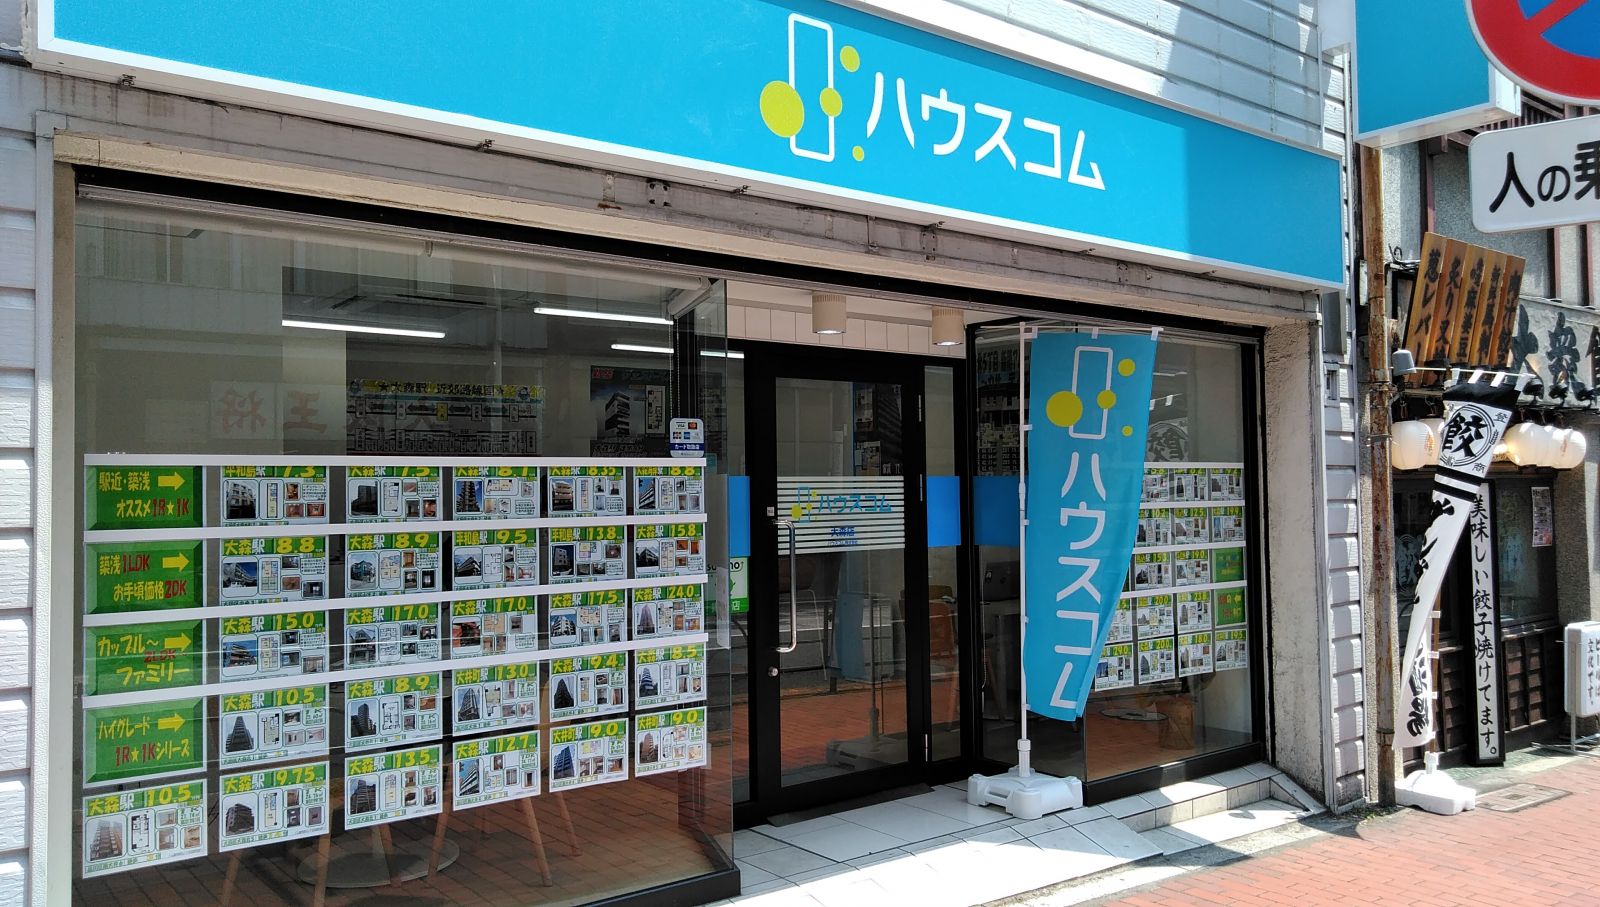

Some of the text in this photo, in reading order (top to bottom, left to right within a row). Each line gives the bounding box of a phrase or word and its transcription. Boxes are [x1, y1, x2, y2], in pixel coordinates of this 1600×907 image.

[867, 71, 1107, 191] ハウスコム
[1443, 412, 1488, 457] 餃
[99, 471, 151, 492] 駅近・築浅
[819, 495, 892, 513] ハウスコム
[351, 533, 430, 550] 大森駅 8.9
[456, 530, 528, 546] 平和島駅 9.5
[551, 527, 616, 543] 平和島駅 13.8
[637, 524, 696, 539] 大森駅 15.8
[225, 537, 315, 555] 大森駅 8.8
[1050, 451, 1107, 709] ハウスコム
[113, 580, 187, 602] お手頃価格2DK
[552, 590, 618, 609] 大森駅 17.5
[635, 584, 694, 602] 大森駅 24.0
[349, 605, 429, 624] 大森駅 17.0
[453, 597, 527, 616] 大森駅 17.0
[224, 613, 314, 634] 大森駅 15.0
[1470, 497, 1497, 755] 美味しい餃子焼けてます。
[553, 655, 618, 674] 大森駅 9.4
[638, 645, 697, 664] 大森駅 8.5
[116, 662, 190, 686] ファミリー
[456, 664, 528, 685] 大井町駅 13.0
[351, 676, 430, 697] 大森駅 8.9
[224, 688, 315, 712] 大森駅 10.5
[98, 716, 150, 740] ハイグレード
[638, 709, 698, 729] 大井町駅 9.0
[552, 722, 618, 743] 大井町駅 9.0
[455, 734, 529, 759] 大森駅 12.7
[349, 747, 430, 775] 大森駅 13.5
[223, 769, 314, 793] 大森駅 9.75
[87, 785, 191, 817] 大森駅 10.5
